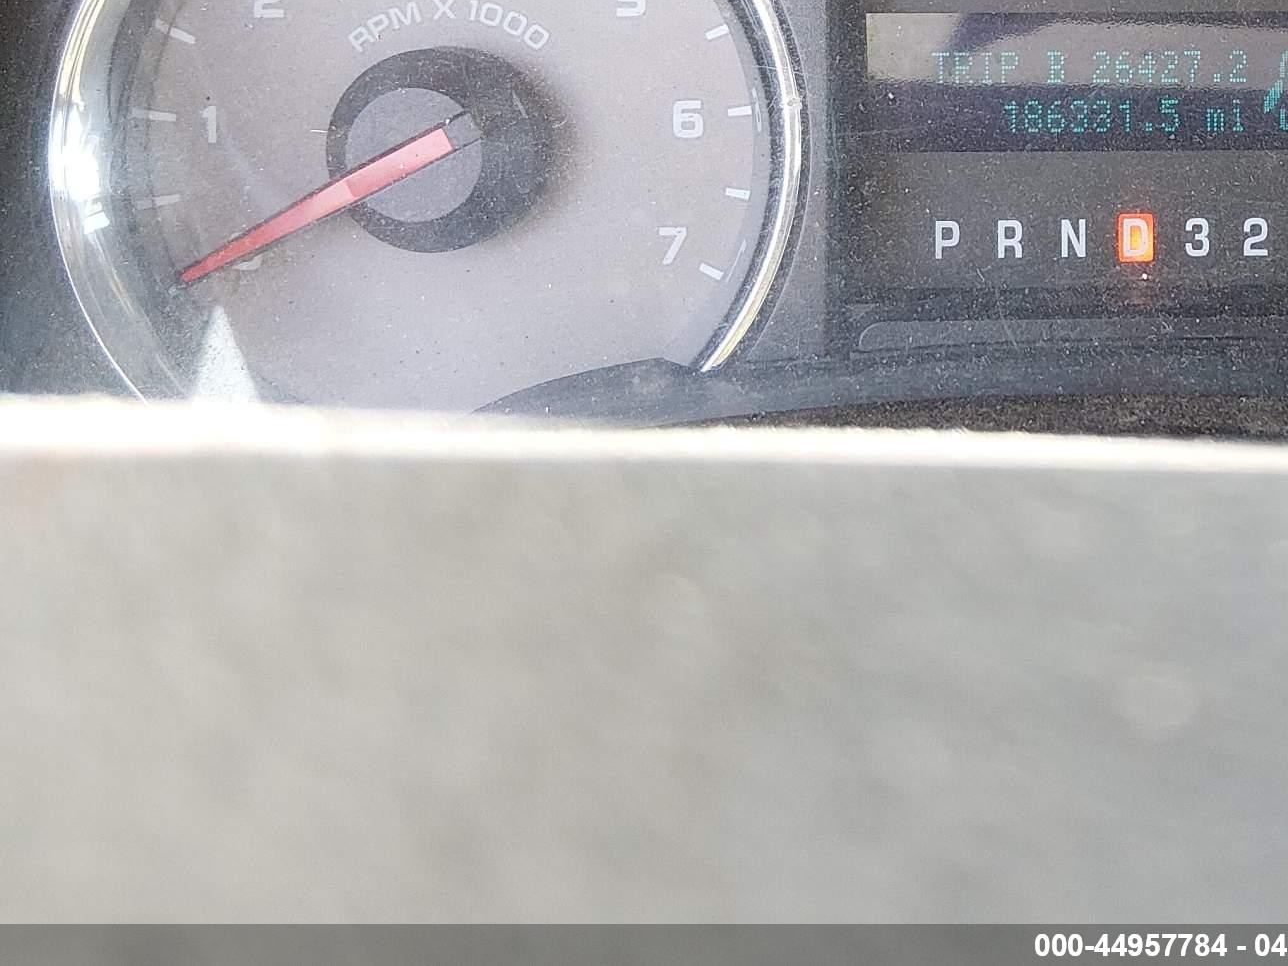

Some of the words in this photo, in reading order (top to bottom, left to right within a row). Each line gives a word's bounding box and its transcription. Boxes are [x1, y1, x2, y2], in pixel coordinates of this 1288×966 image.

[348, 1, 422, 52] RPM
[470, 0, 550, 51] 1000
[931, 51, 1019, 84] TRIP
[1092, 50, 1246, 83] 26427.2
[201, 105, 216, 143] 1
[672, 100, 703, 138] 6
[1206, 99, 1244, 132] mi
[658, 227, 687, 265] 7
[935, 220, 960, 259] P
[997, 219, 1023, 258] R
[1061, 218, 1086, 258] N
[1123, 218, 1148, 257] D
[1185, 218, 1210, 256] 3
[1243, 218, 1268, 256] 2
